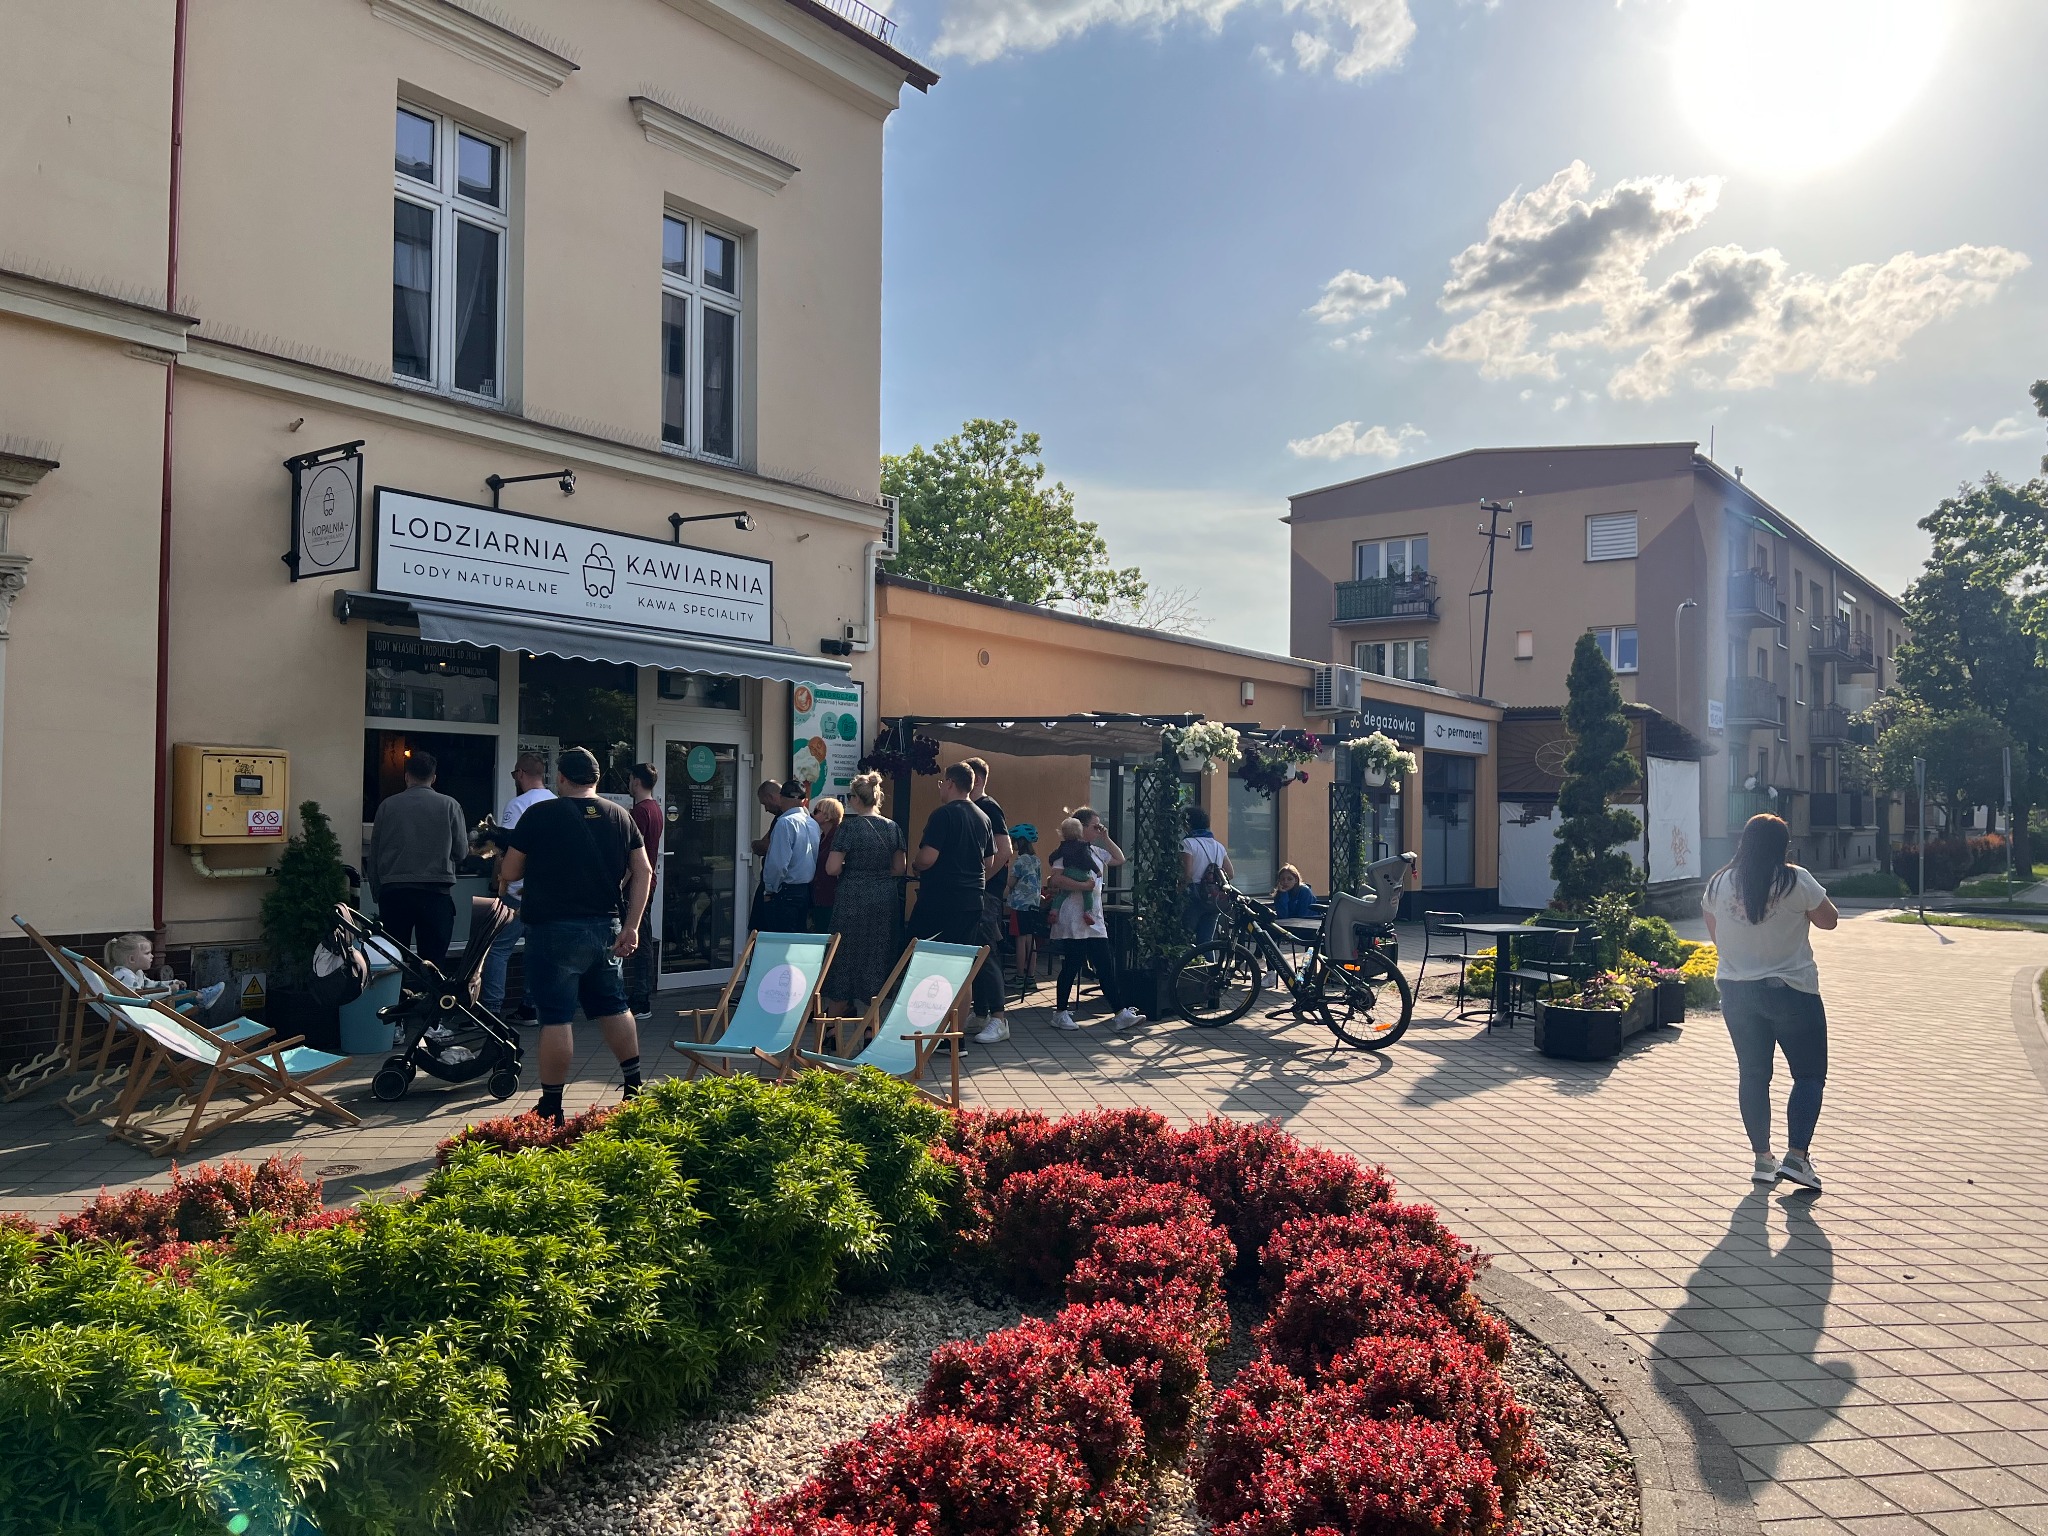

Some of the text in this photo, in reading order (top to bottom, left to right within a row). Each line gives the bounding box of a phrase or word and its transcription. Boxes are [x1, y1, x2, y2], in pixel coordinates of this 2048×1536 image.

[311, 521, 345, 536] KOPALNIA
[391, 513, 568, 563] LODZIARNIA
[403, 561, 558, 595] LODY NATURALNE
[627, 554, 763, 595] KAWIARNIA
[637, 596, 754, 623] KAWA SPECIALITY
[375, 640, 391, 651] LODY
[422, 645, 456, 659] PRODUKCJI
[1363, 709, 1415, 732] degażówka
[1447, 727, 1482, 741] permanent
